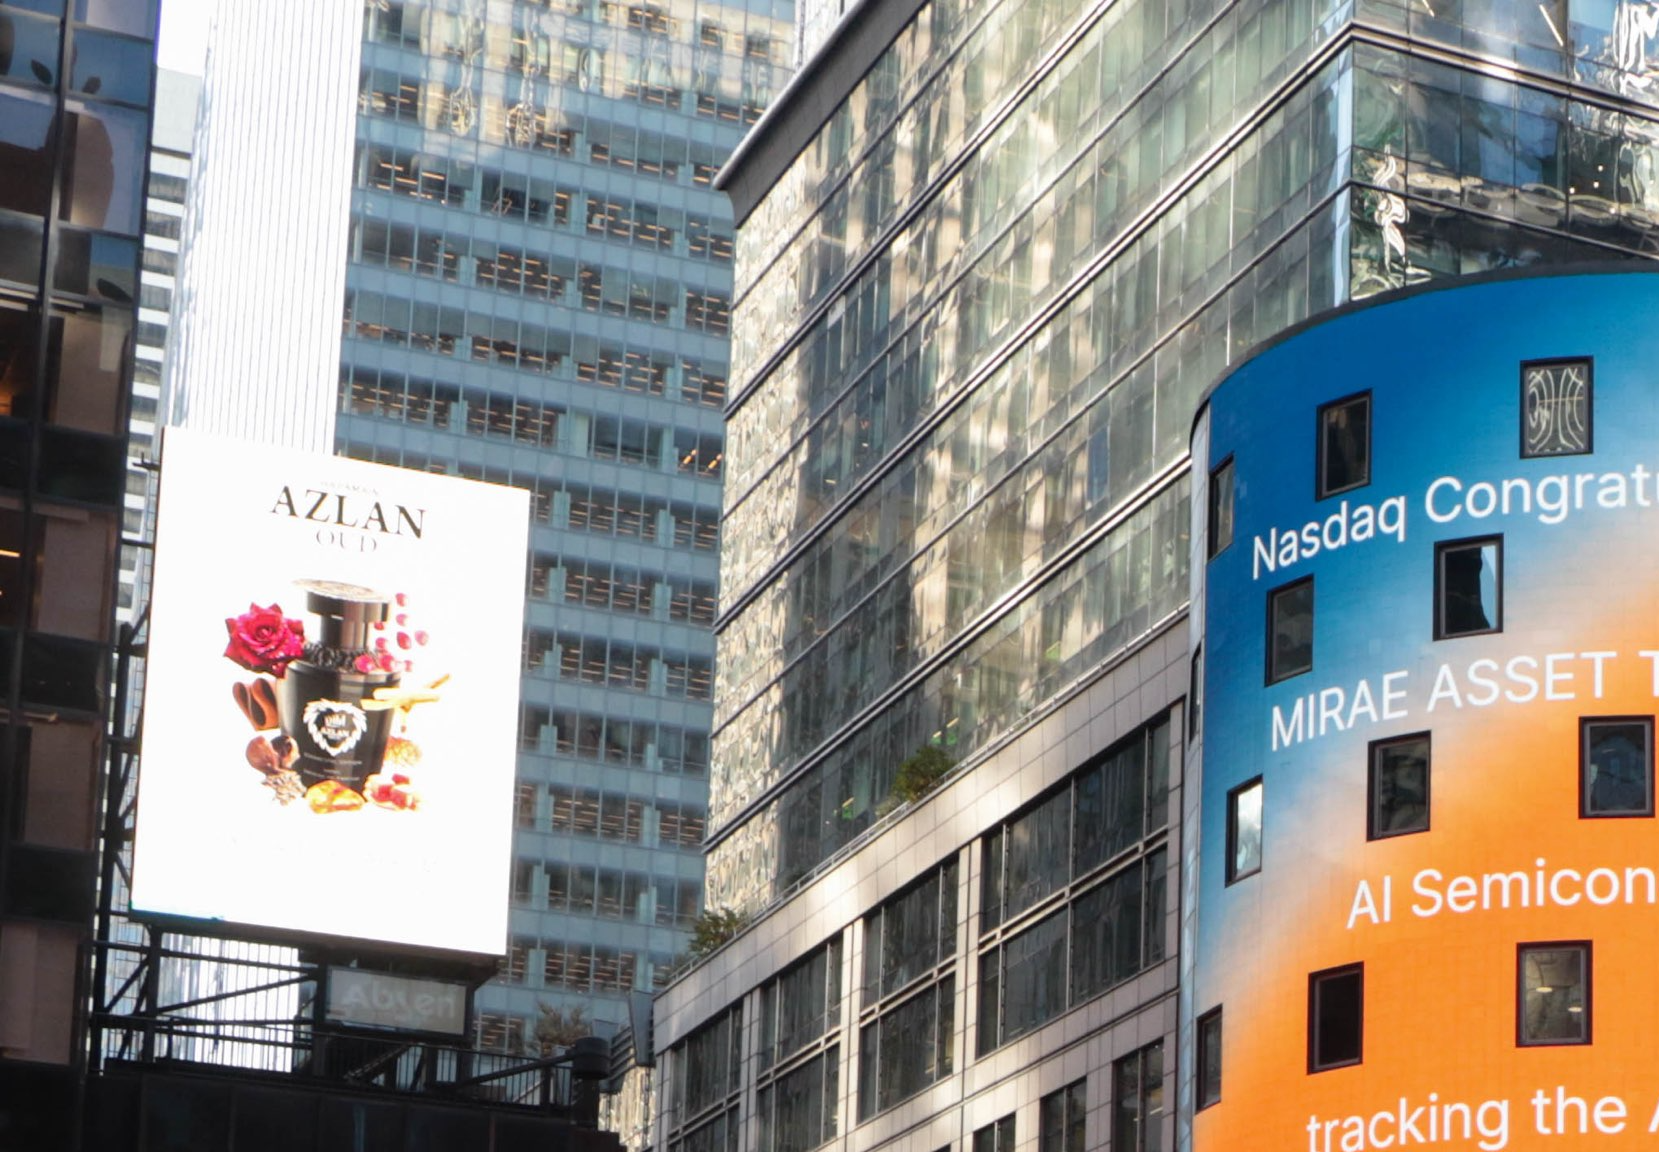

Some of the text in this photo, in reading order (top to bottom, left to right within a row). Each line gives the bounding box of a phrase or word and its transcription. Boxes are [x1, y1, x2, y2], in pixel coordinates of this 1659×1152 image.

[270, 485, 427, 539] AZLAN
[1252, 495, 1407, 580] Nasdaq
[315, 530, 378, 552] OUD
[1270, 670, 1409, 752] MIRAE
[1426, 651, 1617, 713] ASSET
[1346, 874, 1392, 929] AI
[1531, 1084, 1627, 1136] the
